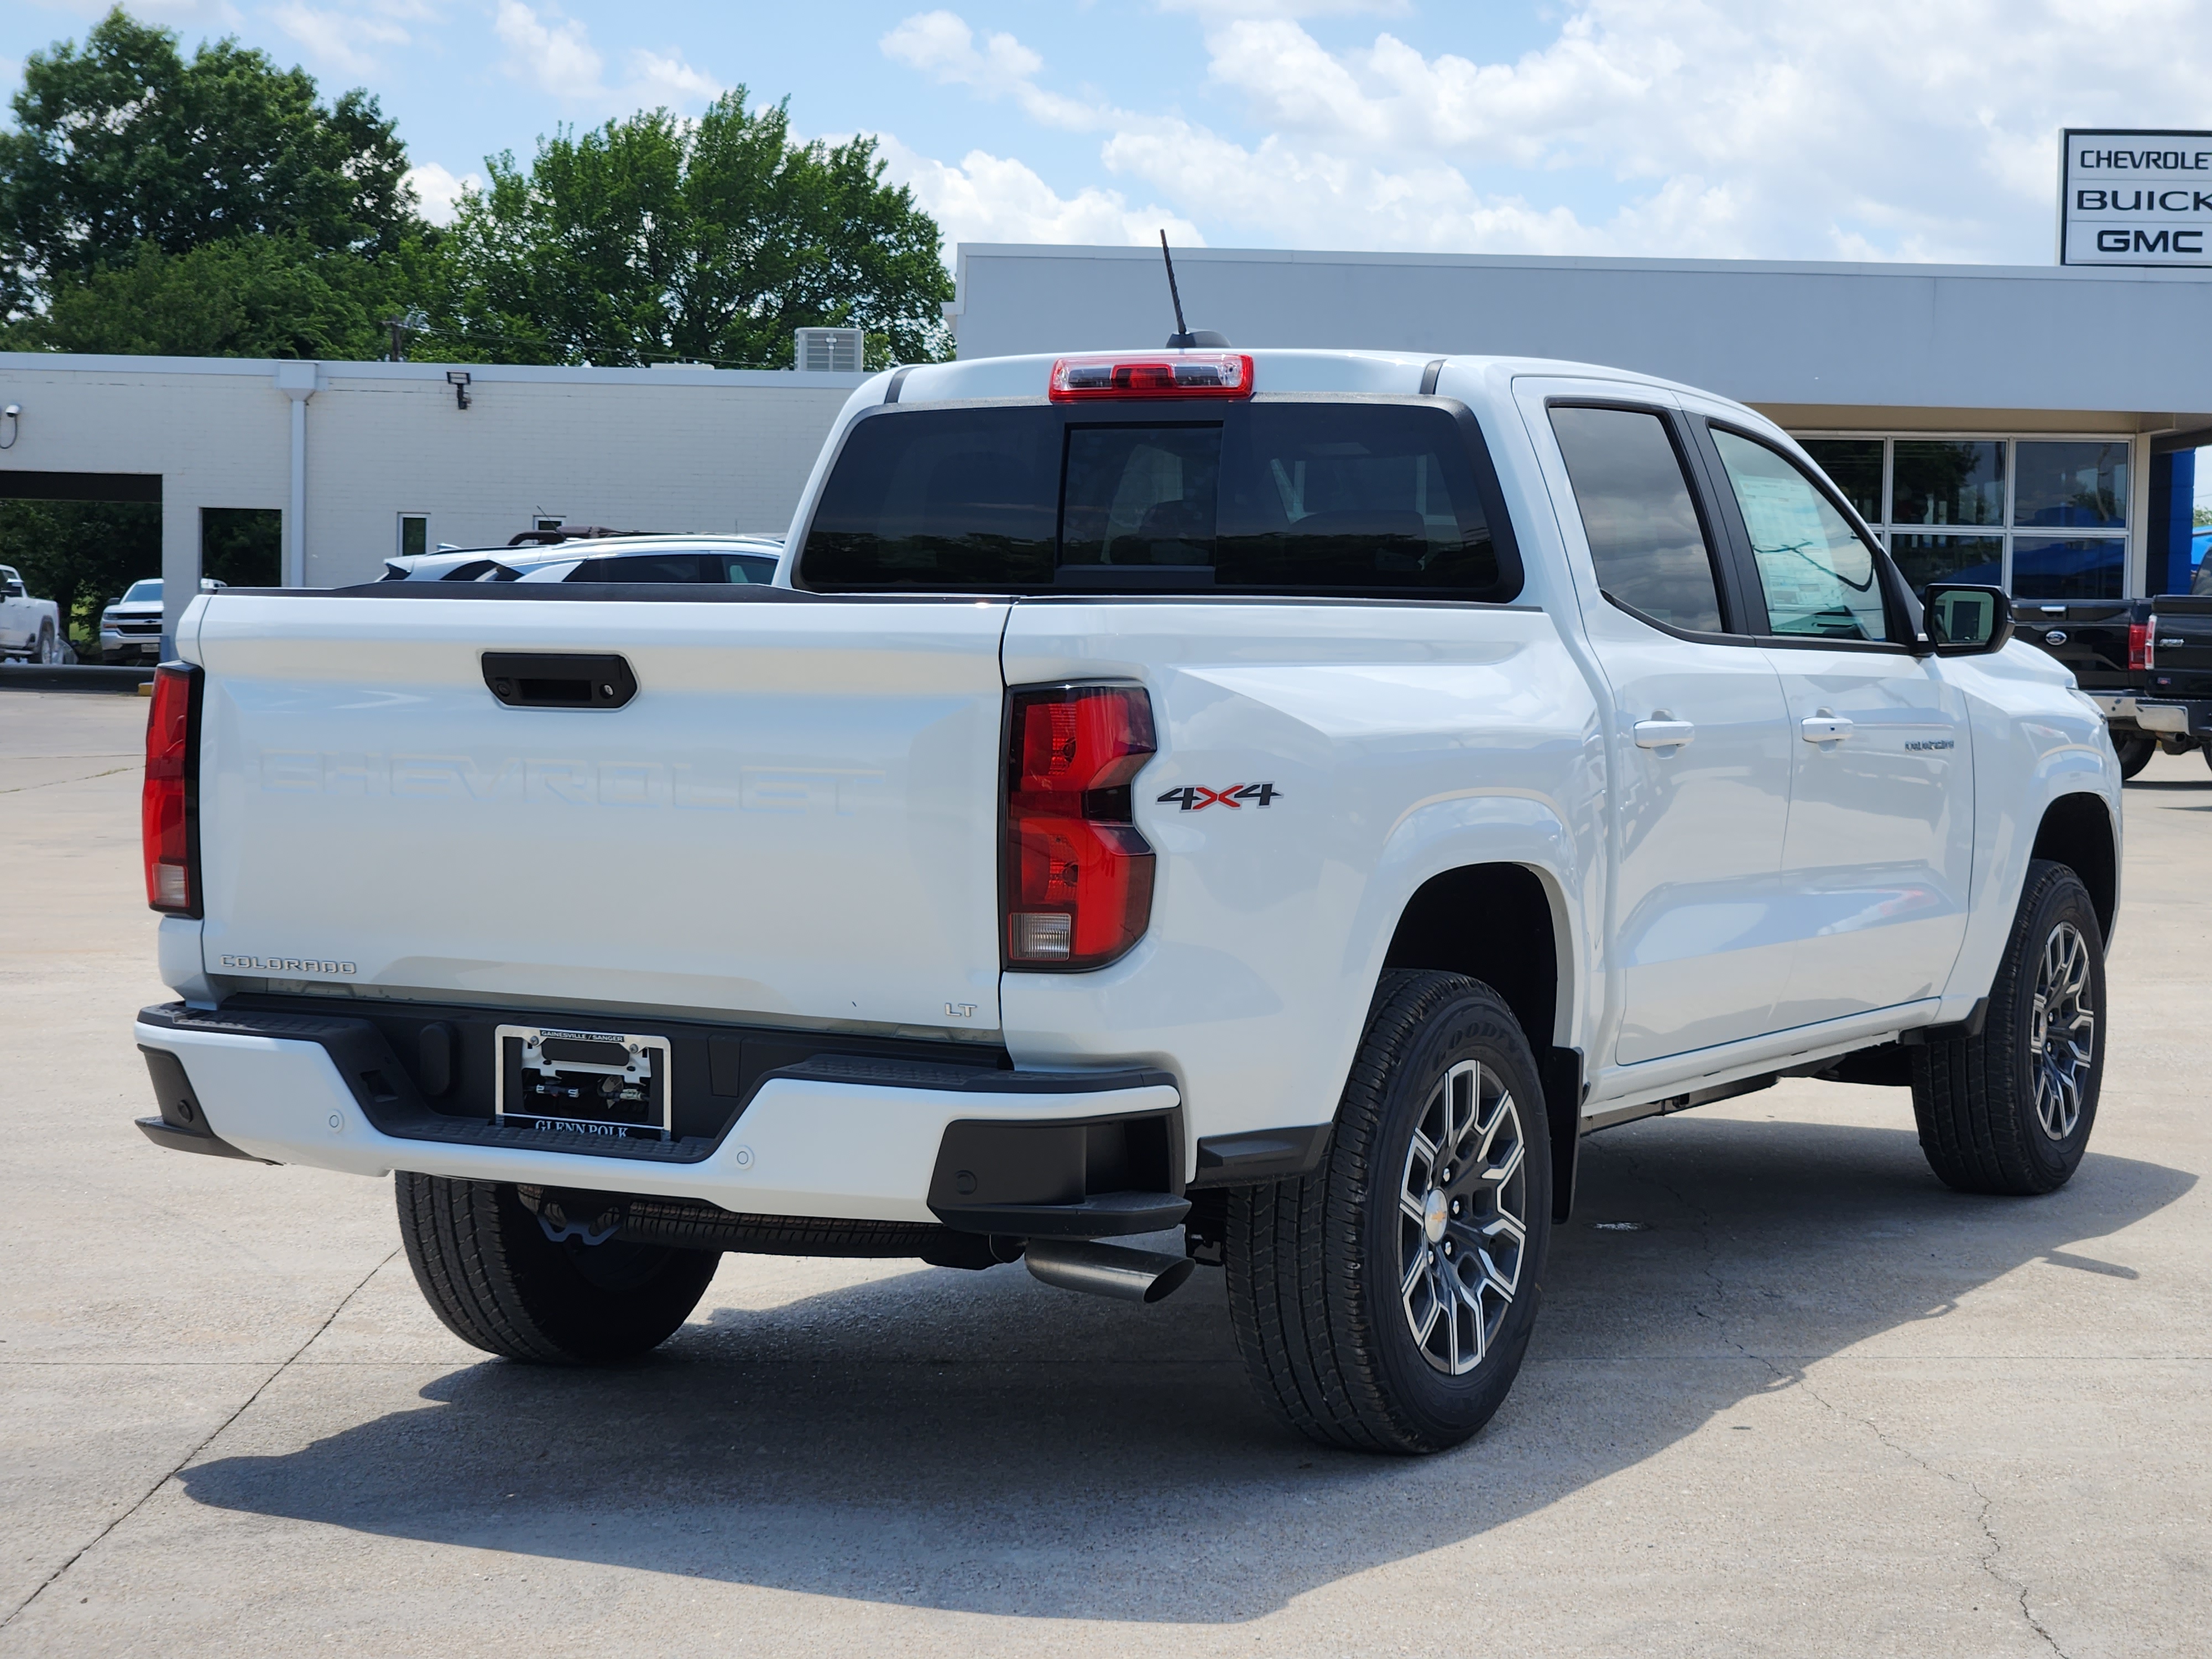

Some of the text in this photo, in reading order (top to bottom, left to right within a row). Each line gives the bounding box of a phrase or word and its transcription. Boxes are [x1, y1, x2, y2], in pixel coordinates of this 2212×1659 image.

[2080, 150, 2212, 170] CHEVROLE
[2077, 190, 2212, 211] BUICK
[2097, 230, 2203, 253] GMC
[259, 748, 888, 816] CHEVROLET
[220, 954, 357, 974] COLORADO
[945, 1002, 977, 1018] LT
[541, 1031, 587, 1040] GAINESVILLE
